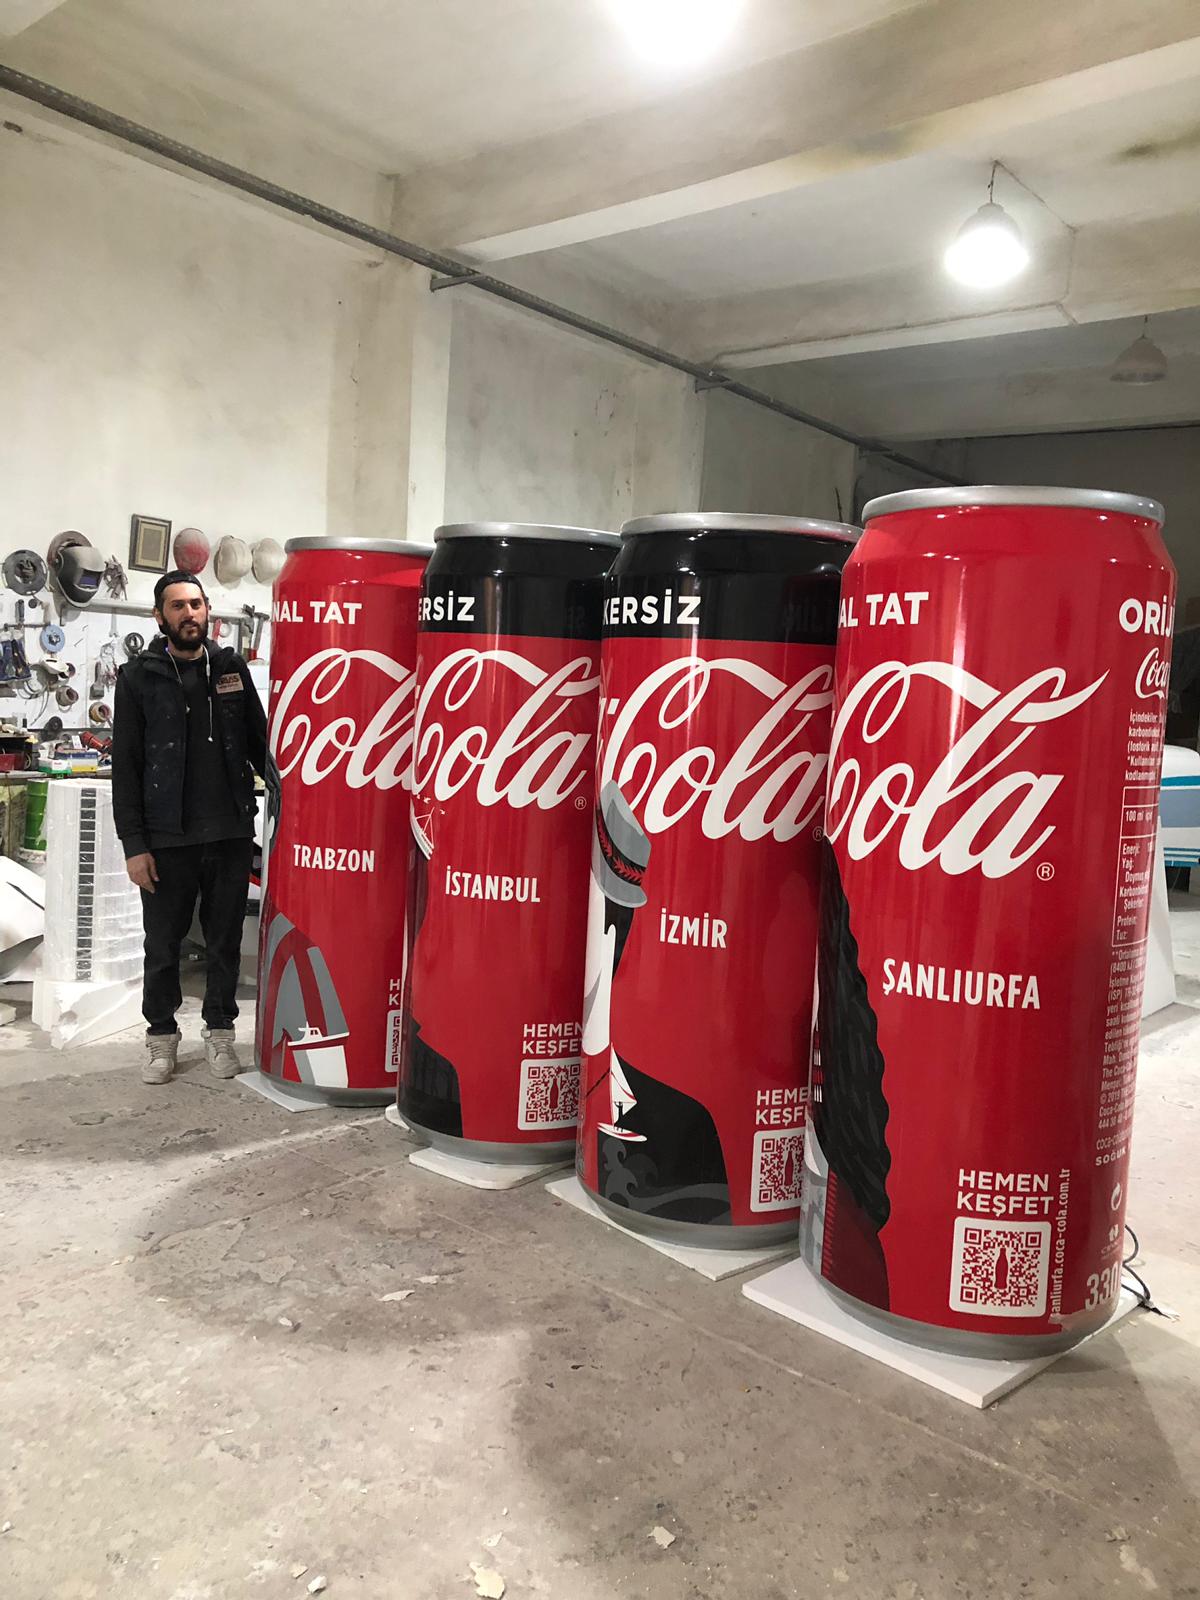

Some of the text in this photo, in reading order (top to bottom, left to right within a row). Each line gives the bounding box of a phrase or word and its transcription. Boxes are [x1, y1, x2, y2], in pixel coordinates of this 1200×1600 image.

[310, 602, 362, 624] TAT
[866, 592, 929, 625] TAT
[826, 659, 1109, 880] Cola
[293, 843, 375, 873] TRABZON
[444, 865, 541, 904] İSTANBUL
[658, 907, 728, 949] İZMİR
[882, 957, 1041, 1011] ŞANLIURFA
[958, 1168, 1049, 1192] HEMEN
[956, 1191, 1054, 1218] KEŞFET
[1049, 1168, 1071, 1321] anliurfa.coca-cola.com.tr
[1085, 1261, 1119, 1312] 330
